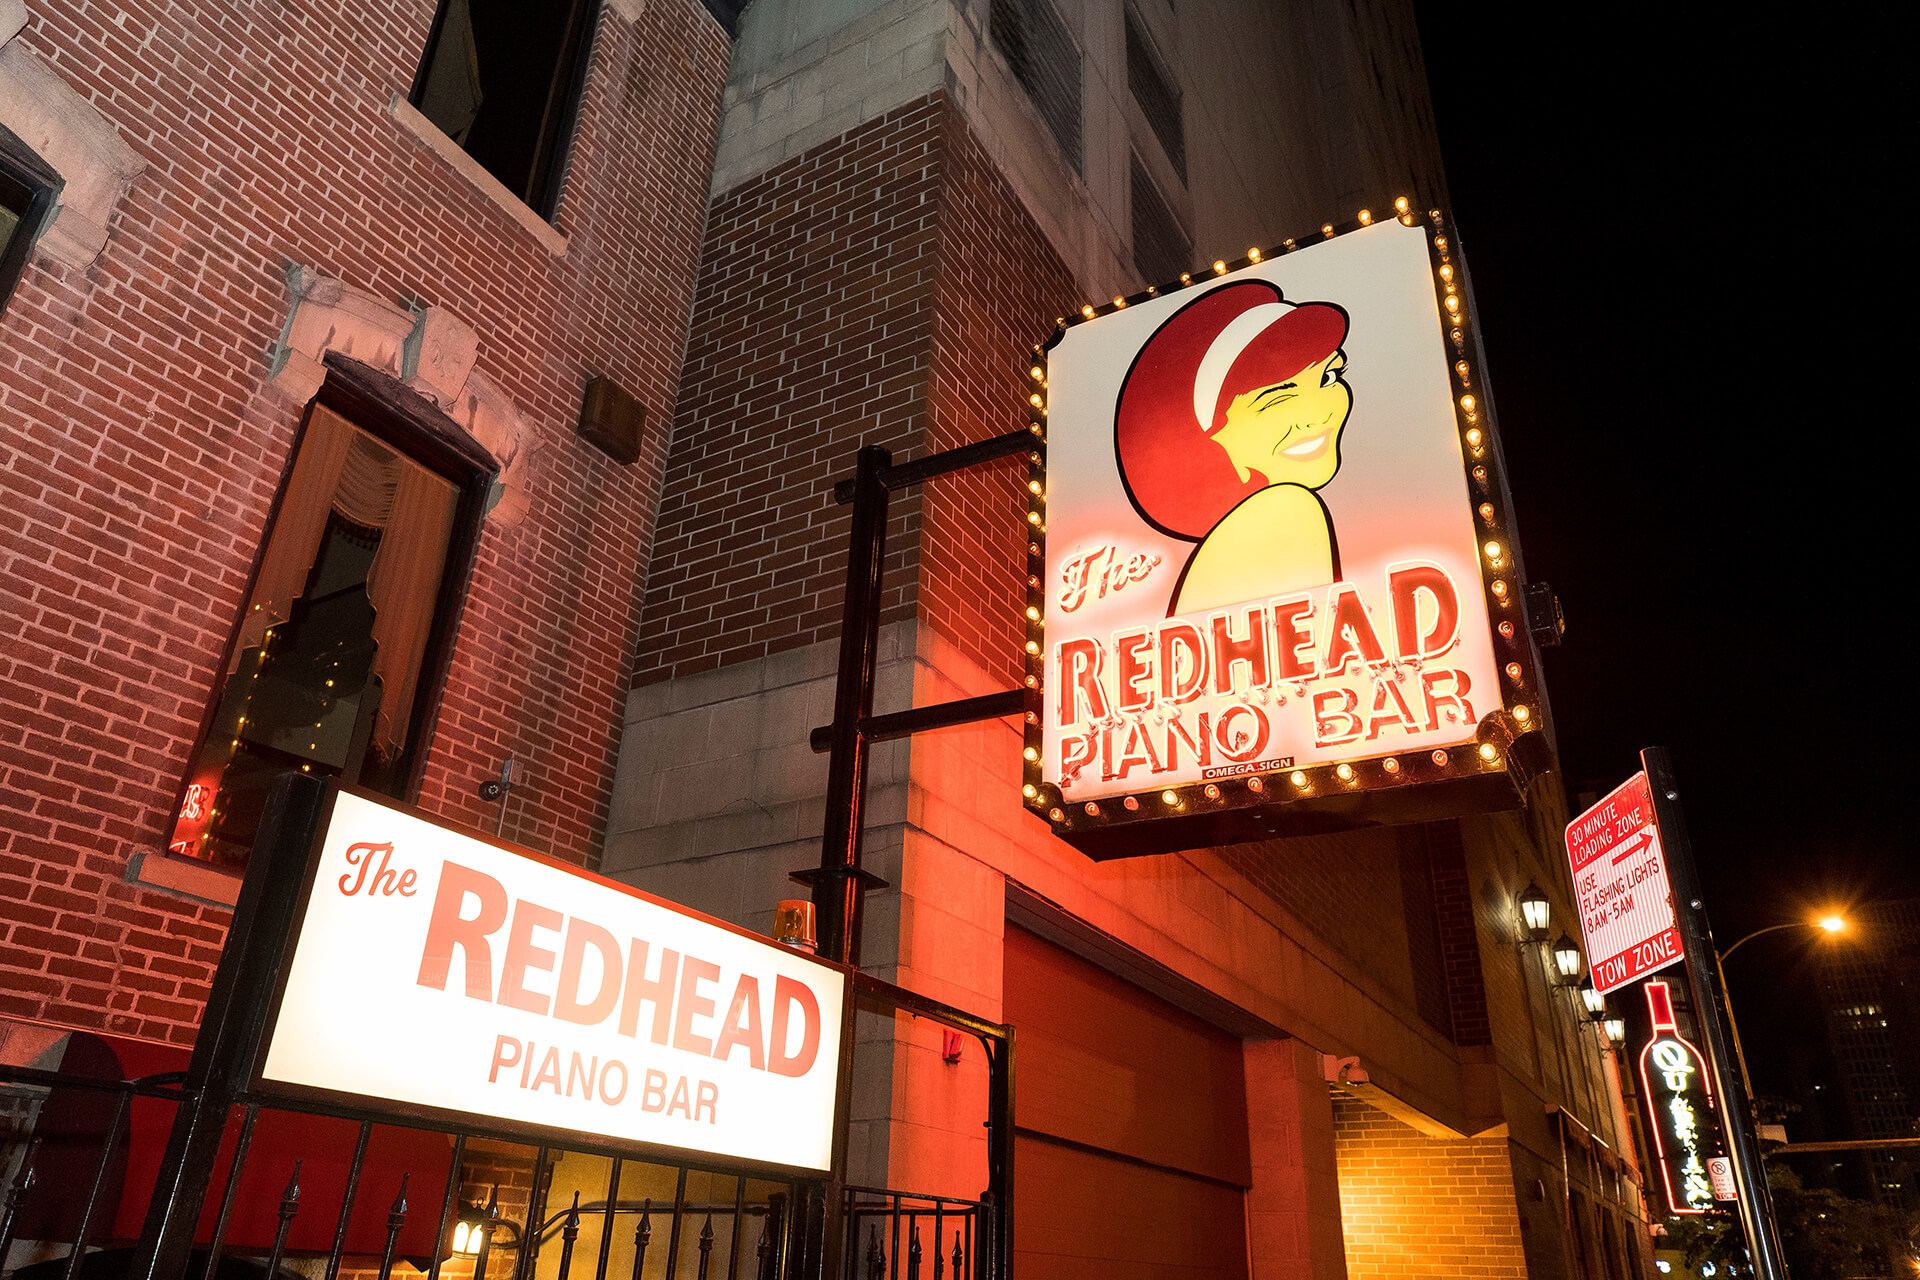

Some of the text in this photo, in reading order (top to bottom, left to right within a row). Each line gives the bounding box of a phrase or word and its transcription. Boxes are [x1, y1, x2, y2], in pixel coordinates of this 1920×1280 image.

[1057, 545, 1161, 613] The
[1055, 560, 1461, 730] REDHEAD
[1058, 667, 1478, 788] PIANO BAR
[1205, 758, 1291, 778] OMEGA SIGN
[1571, 802, 1618, 847] 30 MINUTE
[1574, 807, 1643, 866] LOADING ZONE
[1579, 872, 1598, 896] USE
[1583, 856, 1660, 915] FLASHING LIGHTS
[338, 841, 821, 1078] The REDHEAD
[1596, 931, 1676, 987] TOW ZONE
[488, 1034, 719, 1125] PIANO BAR
